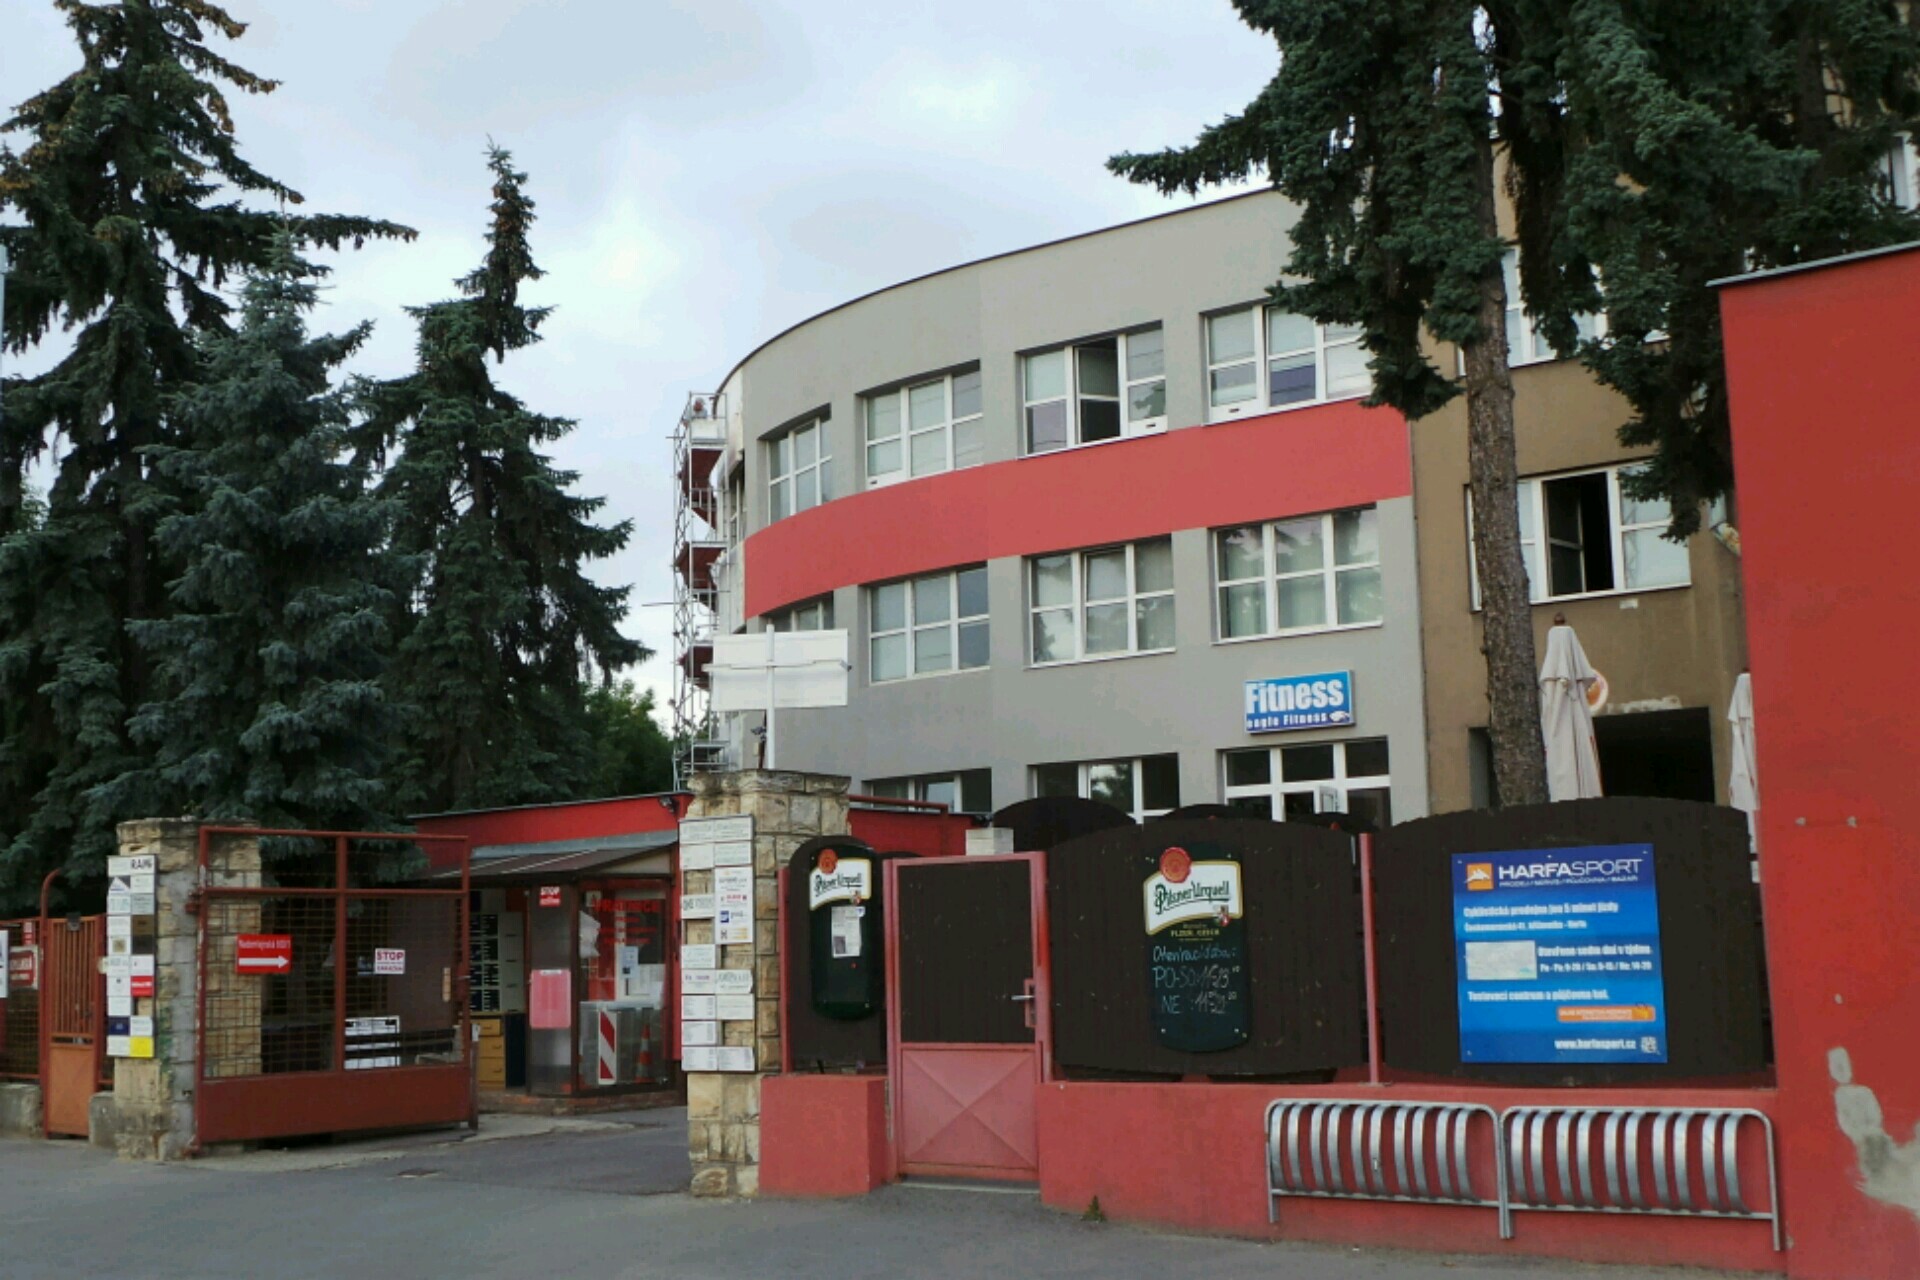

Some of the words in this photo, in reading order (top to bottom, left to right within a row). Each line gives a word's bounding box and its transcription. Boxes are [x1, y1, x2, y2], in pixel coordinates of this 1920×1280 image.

[1245, 679, 1344, 714] Fitness
[1283, 712, 1327, 726] Fitness
[1498, 859, 1643, 880] HARFASPORT
[1154, 883, 1192, 916] Pilsner
[1190, 880, 1230, 904] Urquell
[377, 951, 404, 961] STOP
